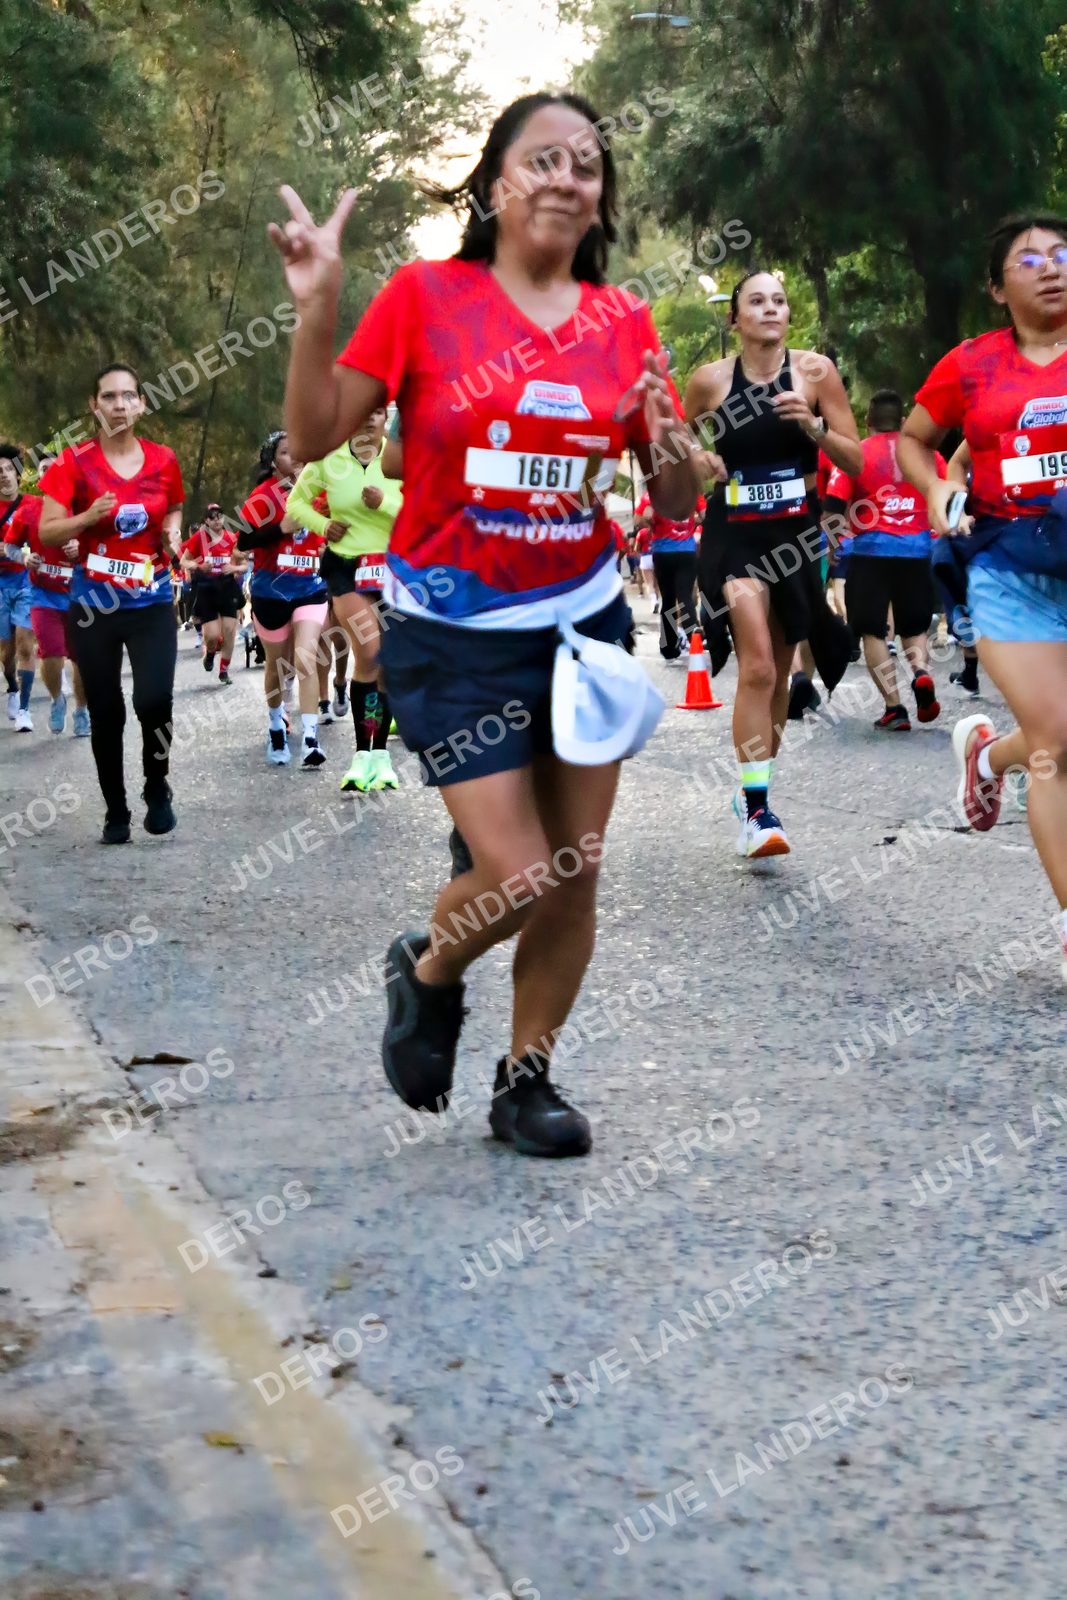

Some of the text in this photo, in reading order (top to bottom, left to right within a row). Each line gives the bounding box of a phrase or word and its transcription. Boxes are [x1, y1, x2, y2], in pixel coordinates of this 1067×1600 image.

[518, 455, 574, 488] 1661
[747, 484, 783, 502] 3883
[108, 560, 136, 577] 3187
